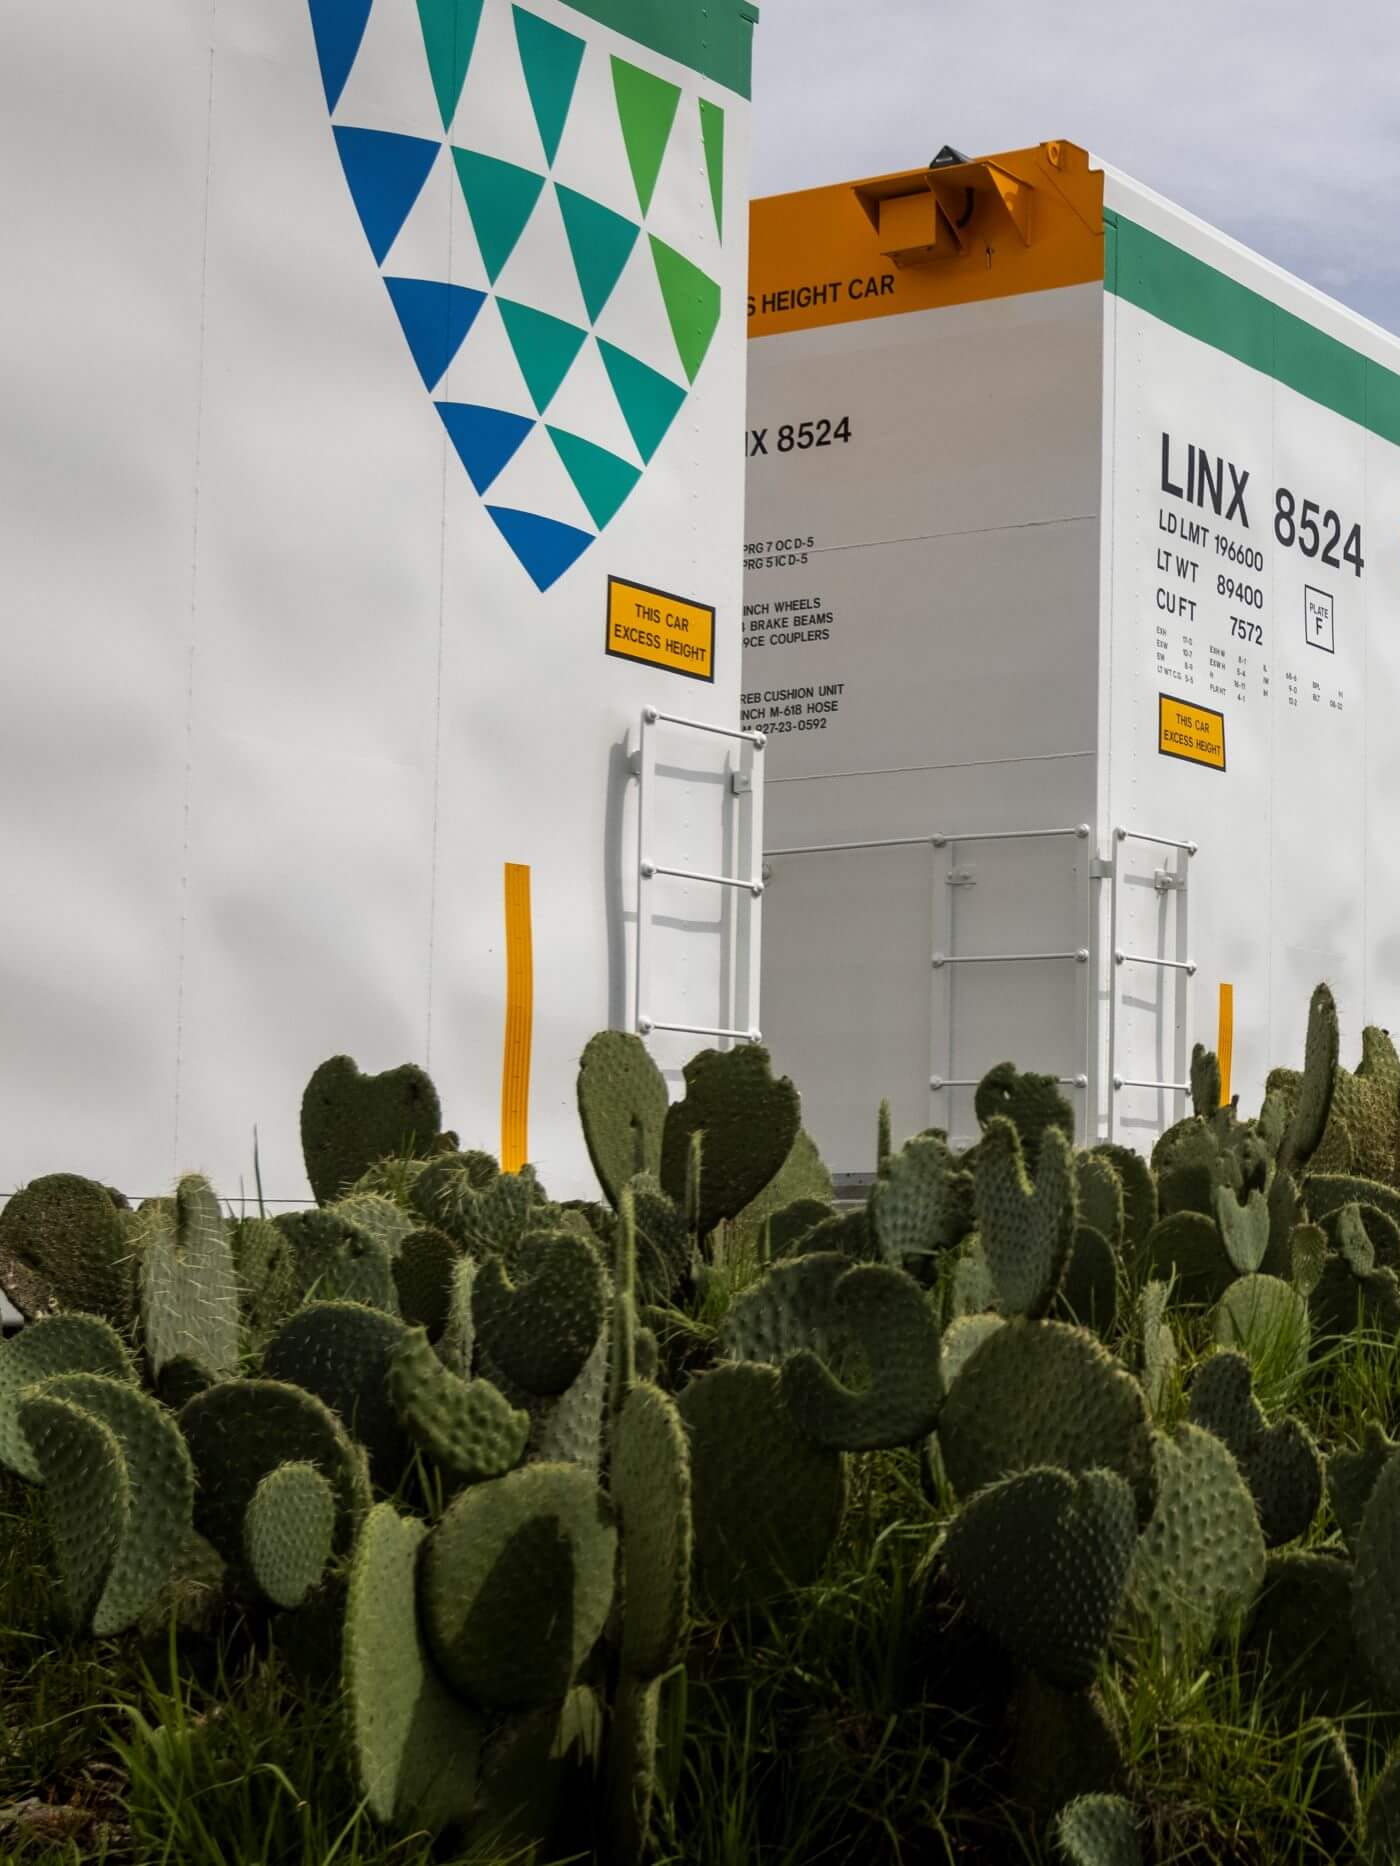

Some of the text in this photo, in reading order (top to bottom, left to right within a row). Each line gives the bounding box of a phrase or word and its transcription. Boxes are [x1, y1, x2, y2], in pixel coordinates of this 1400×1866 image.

[761, 281, 842, 315] HEIGHT
[848, 274, 896, 301] CAR
[776, 415, 853, 453] 8524
[1161, 431, 1365, 578] LINX 8524
[1159, 508, 1264, 572] LD LMT 196600
[1157, 548, 1264, 609] LT WT 89400
[634, 603, 689, 632] THIS CAR
[774, 597, 822, 613] WHEELS
[1156, 588, 1263, 646] CU FT 7572
[1309, 602, 1329, 619] PLATE
[750, 617, 789, 632] BRAKE
[793, 612, 834, 627] BEAMS
[1316, 617, 1323, 636] F
[614, 623, 707, 662] EXCESS HEIGHT
[770, 628, 830, 646] COUPLERS
[764, 687, 814, 702] CUSHION
[819, 683, 845, 697] UNIT
[807, 700, 839, 714] HOSE
[1175, 713, 1209, 733] THIS CAR
[1163, 729, 1221, 757] EXCESS HEIGHT
